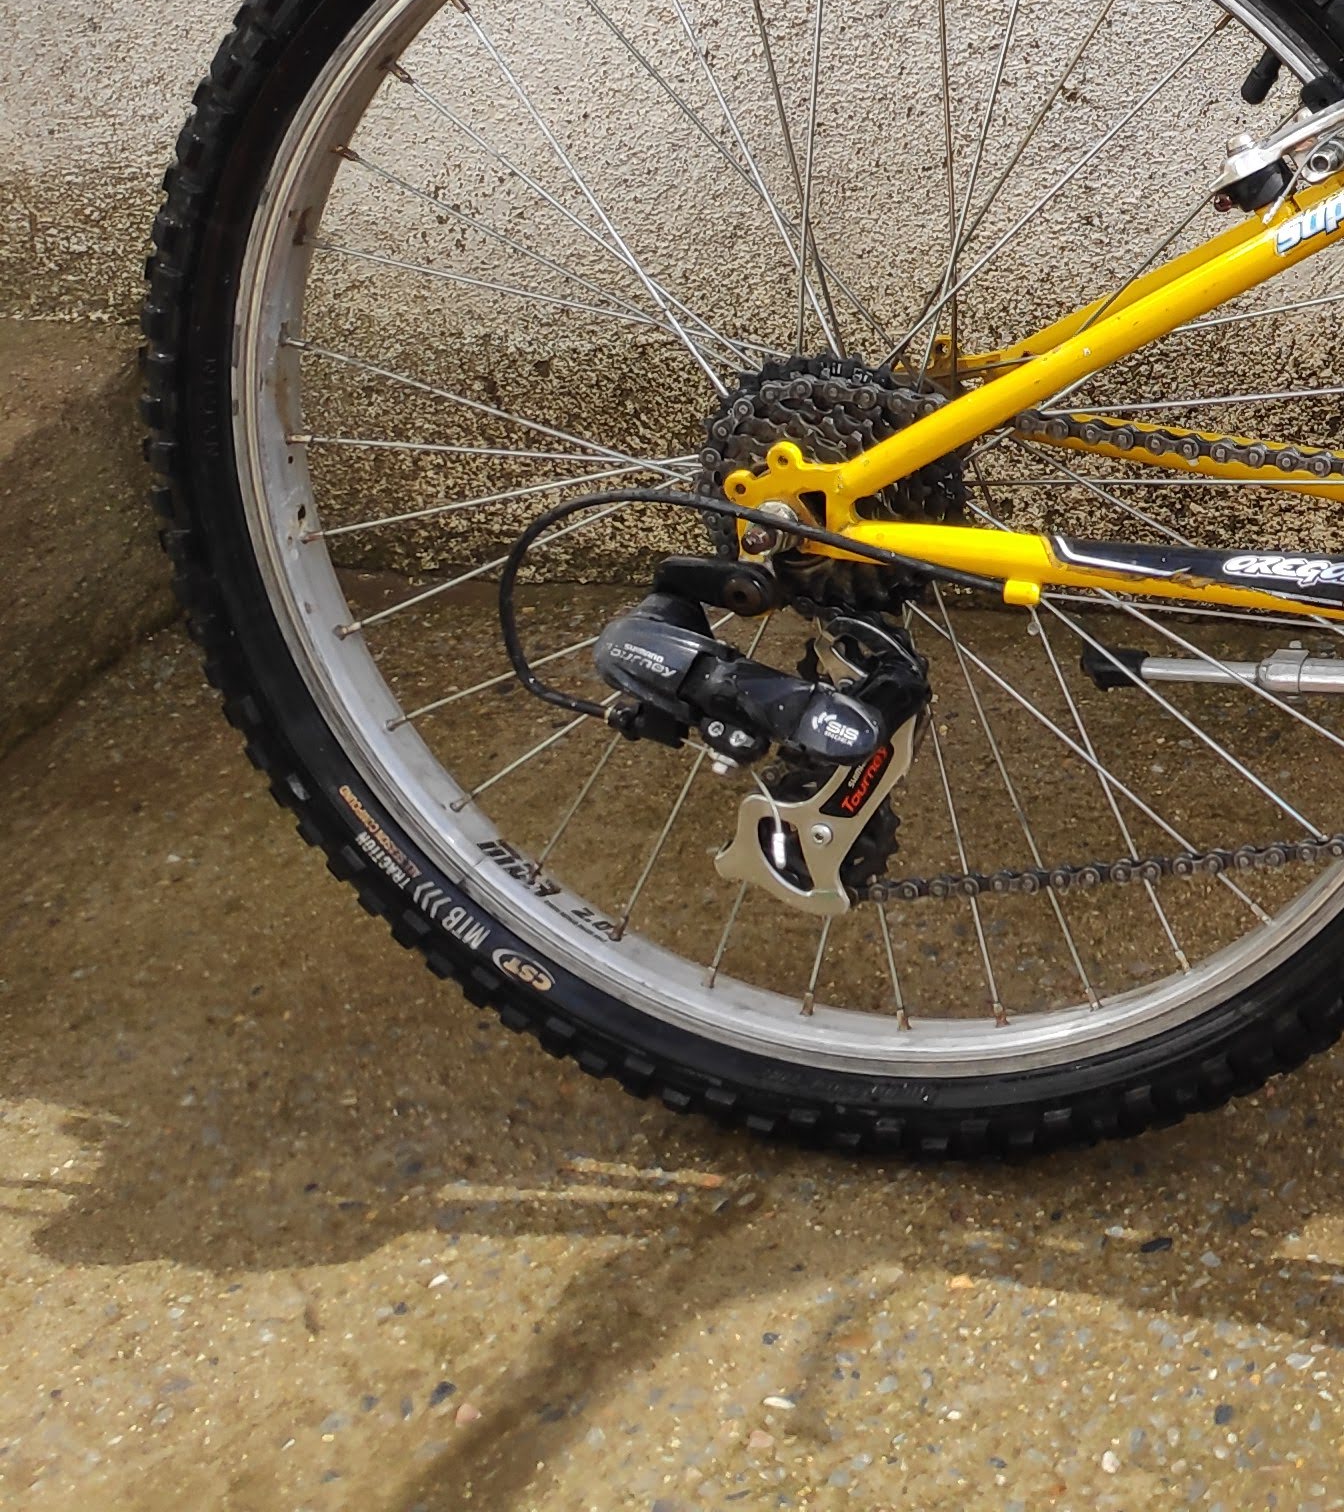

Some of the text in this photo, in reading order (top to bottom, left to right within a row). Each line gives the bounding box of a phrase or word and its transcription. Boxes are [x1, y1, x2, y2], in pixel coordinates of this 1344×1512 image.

[825, 720, 860, 742] SIS
[354, 830, 413, 890] TRACTION
[441, 906, 492, 951] MTB
[502, 957, 553, 992] CST
